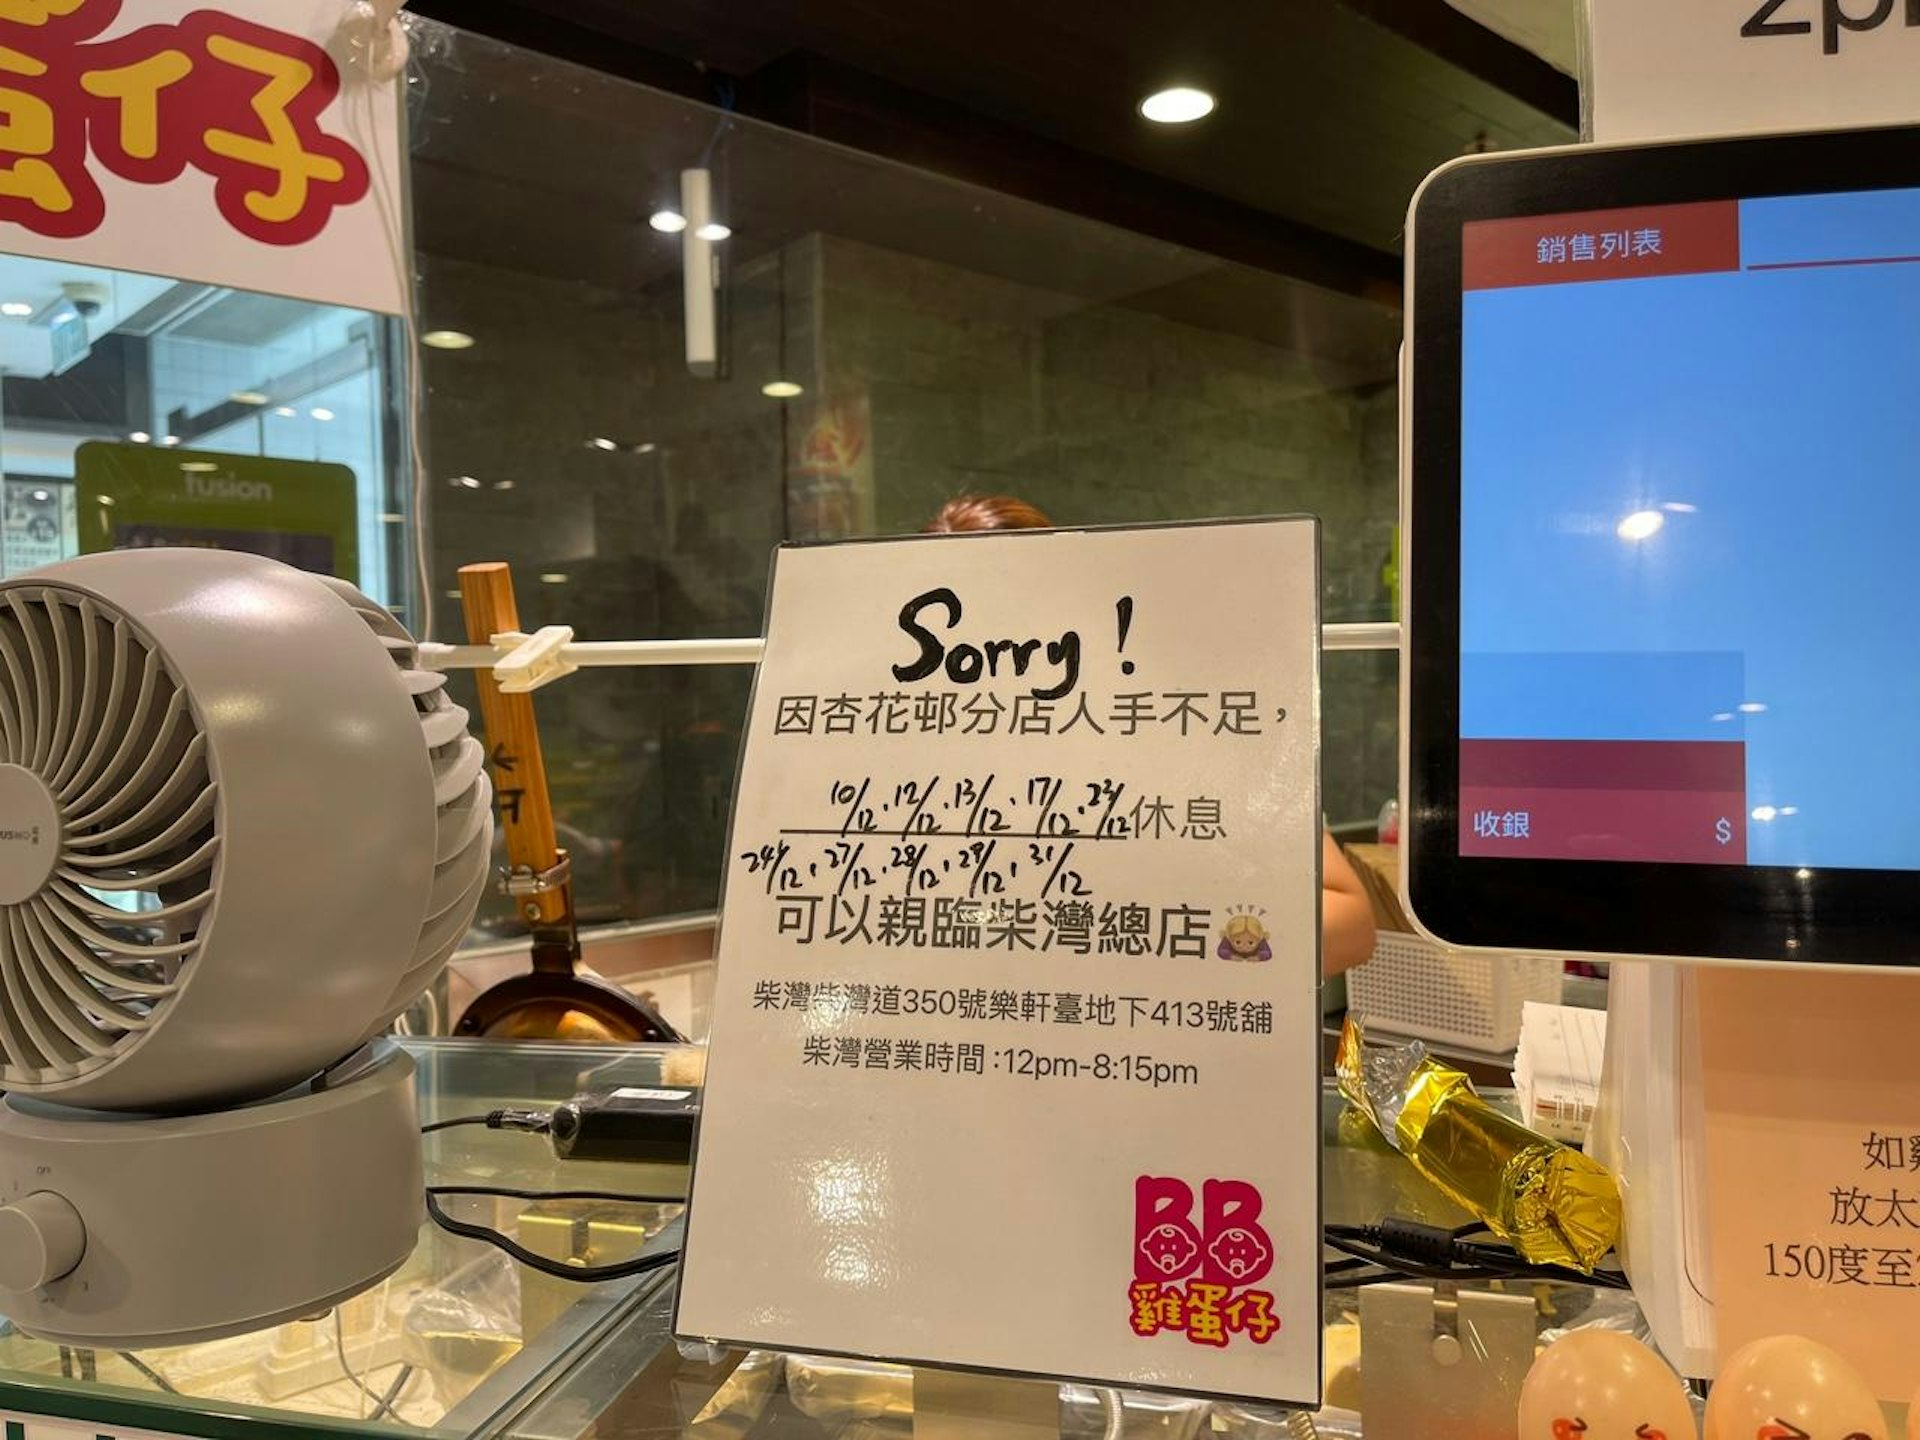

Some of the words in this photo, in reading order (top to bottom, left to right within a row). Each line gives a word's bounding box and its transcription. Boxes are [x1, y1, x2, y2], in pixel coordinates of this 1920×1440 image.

[1536, 228, 1662, 264] 銷售列表
[892, 587, 1081, 700] Sorry
[1115, 596, 1136, 676] !
[1473, 810, 1530, 838] 收銀
[1715, 817, 1732, 844] $
[775, 893, 1212, 960] 可以親臨柴灣總店
[1134, 1175, 1274, 1288] BB
[1764, 1242, 1920, 1288] 150度至
